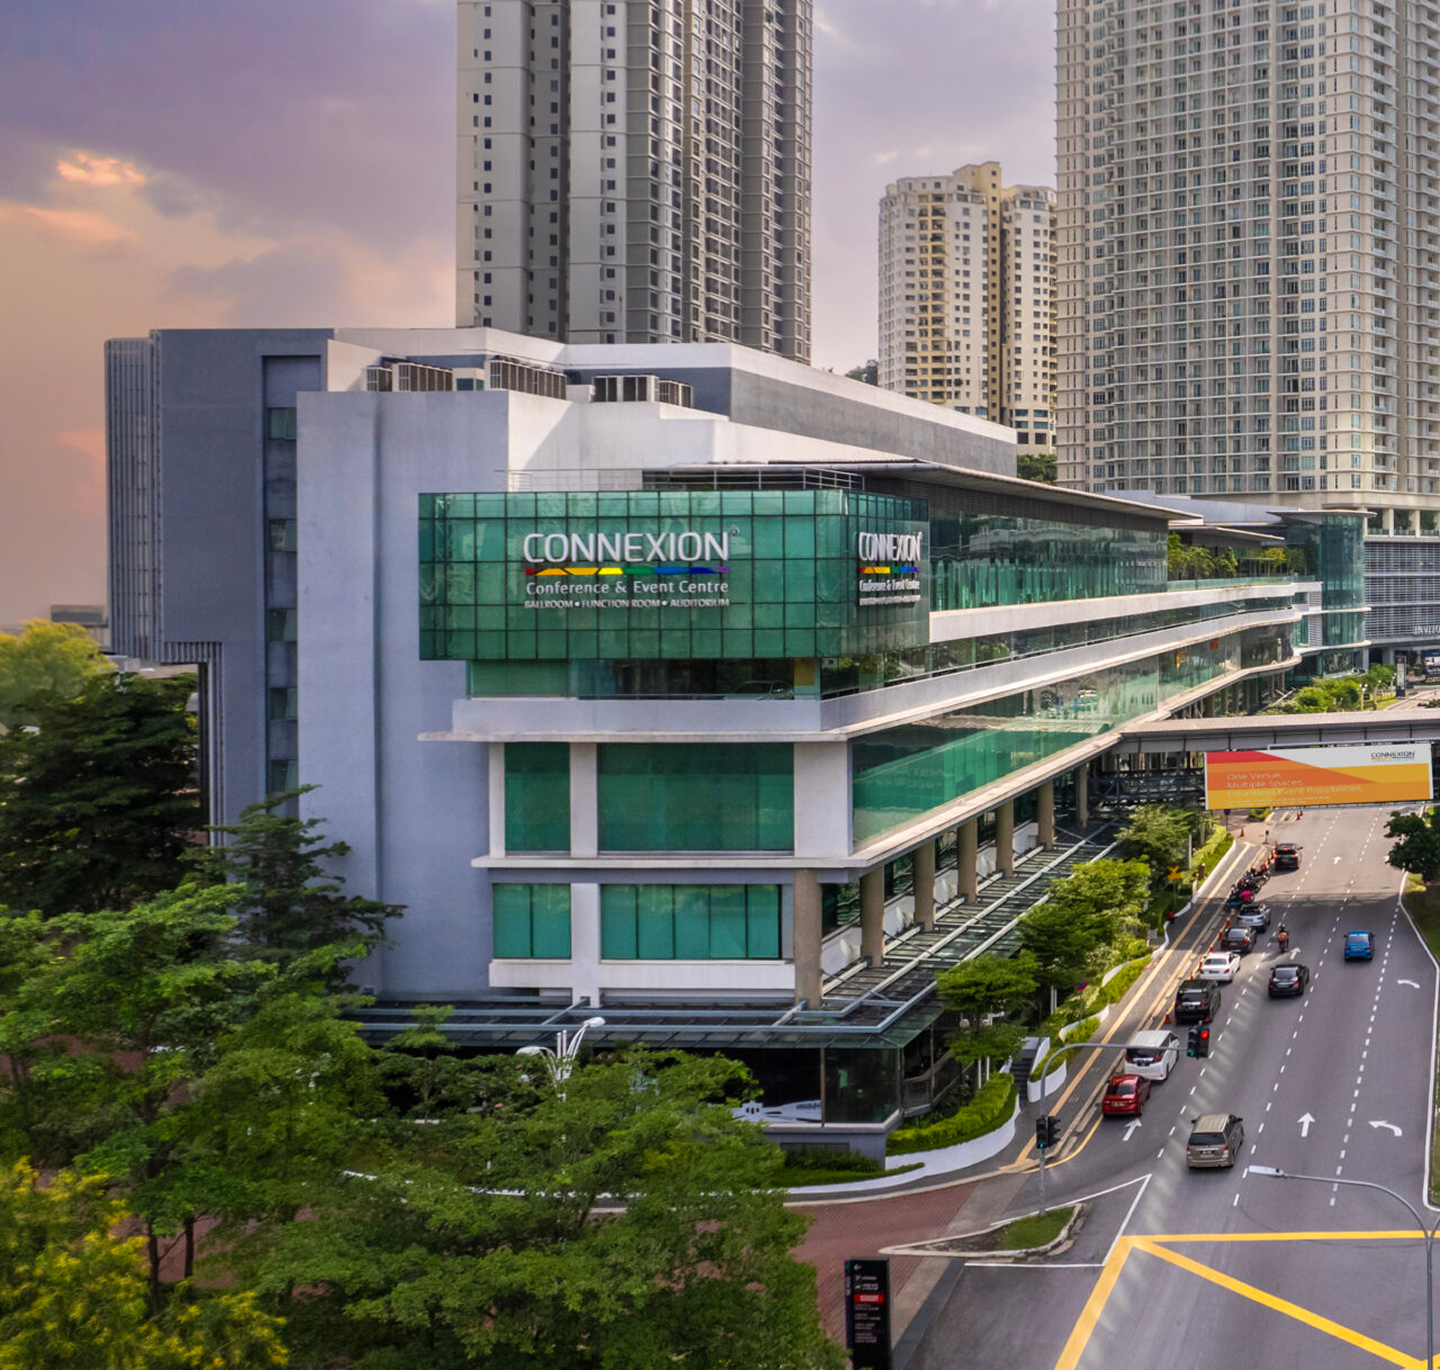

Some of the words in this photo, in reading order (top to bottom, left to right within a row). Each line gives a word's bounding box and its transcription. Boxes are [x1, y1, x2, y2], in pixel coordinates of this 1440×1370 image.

[523, 532, 729, 563] CONNEXION
[858, 531, 920, 561] CONNEXION
[526, 581, 609, 594] Conference
[615, 581, 627, 593] &
[633, 581, 674, 593] Event
[679, 581, 729, 593] Centre
[524, 600, 573, 609] BALLROOM
[581, 600, 629, 608] FUNCTION
[631, 599, 660, 608] ROOM
[669, 598, 730, 607] AUDITORIUM
[1226, 772, 1248, 781] One
[1226, 780, 1266, 790] Multiple
[1277, 786, 1304, 796] Event
